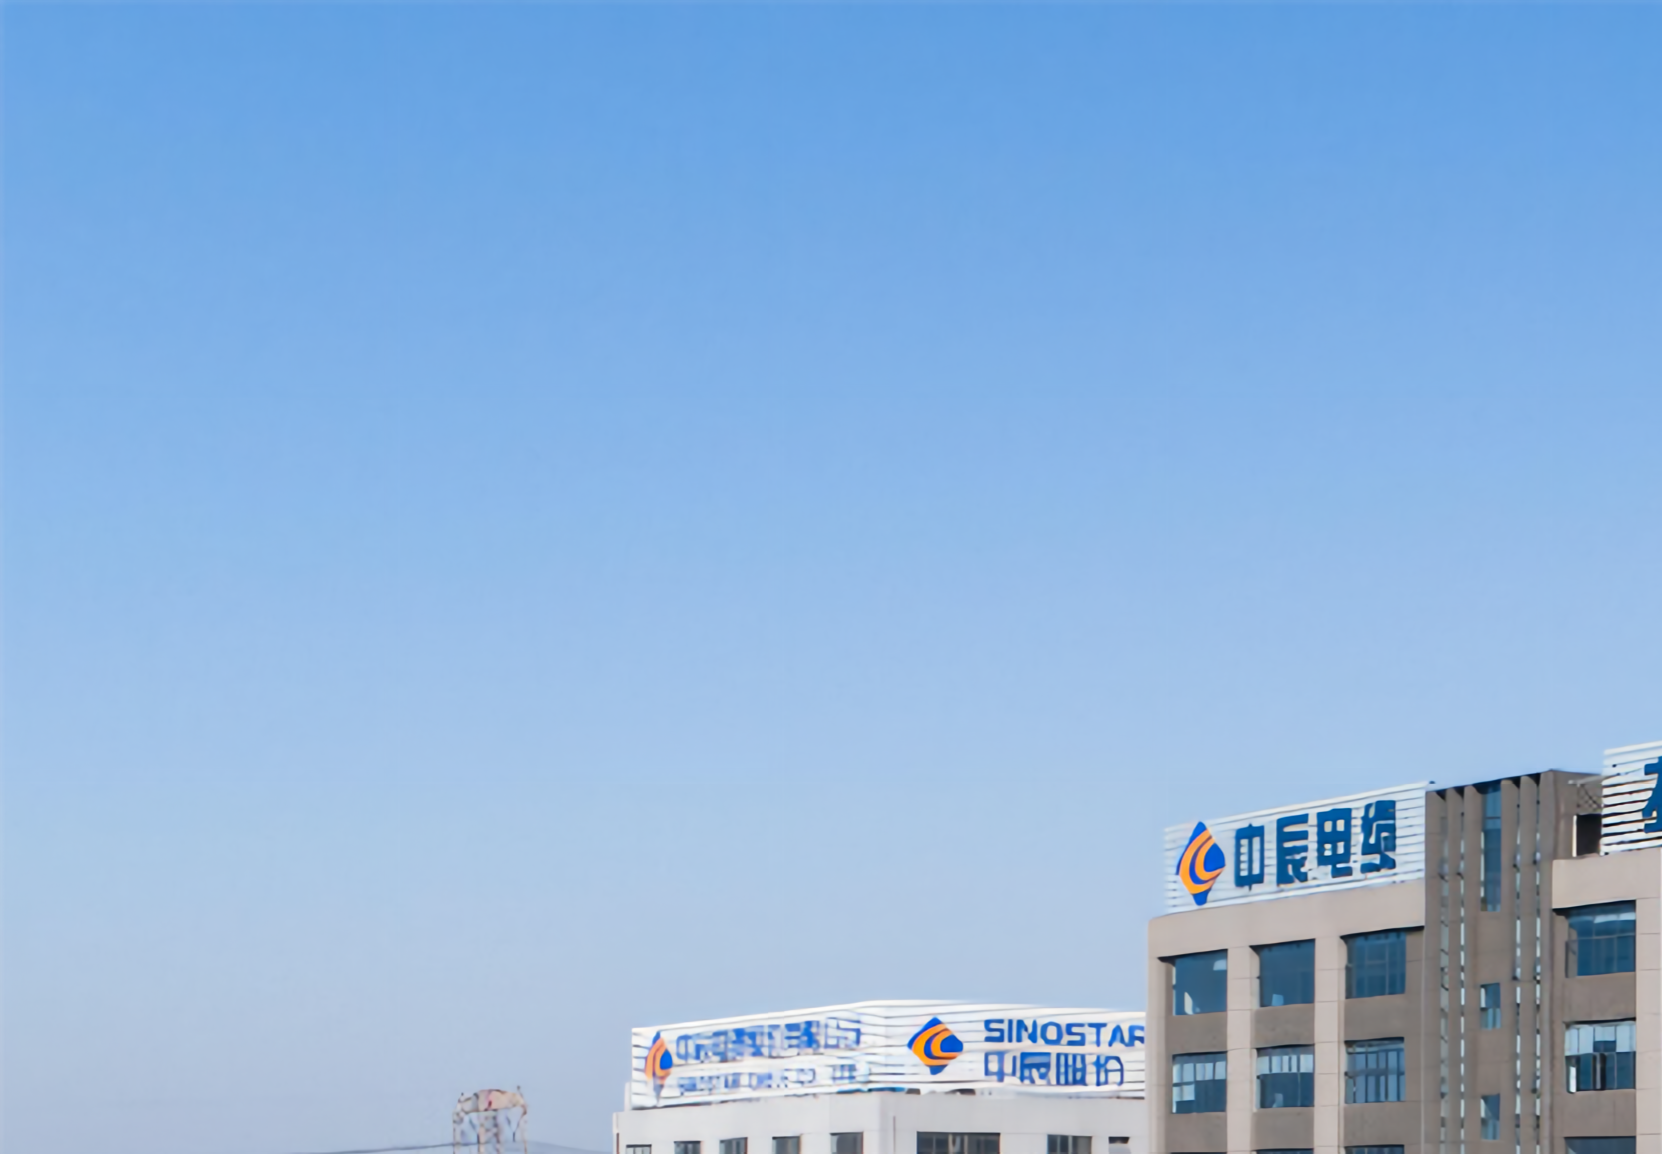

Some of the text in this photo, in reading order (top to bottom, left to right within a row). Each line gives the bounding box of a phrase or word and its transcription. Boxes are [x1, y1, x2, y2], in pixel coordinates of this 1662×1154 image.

[1234, 799, 1398, 891] 中辰电缆
[983, 1018, 1145, 1048] SINOSTAR
